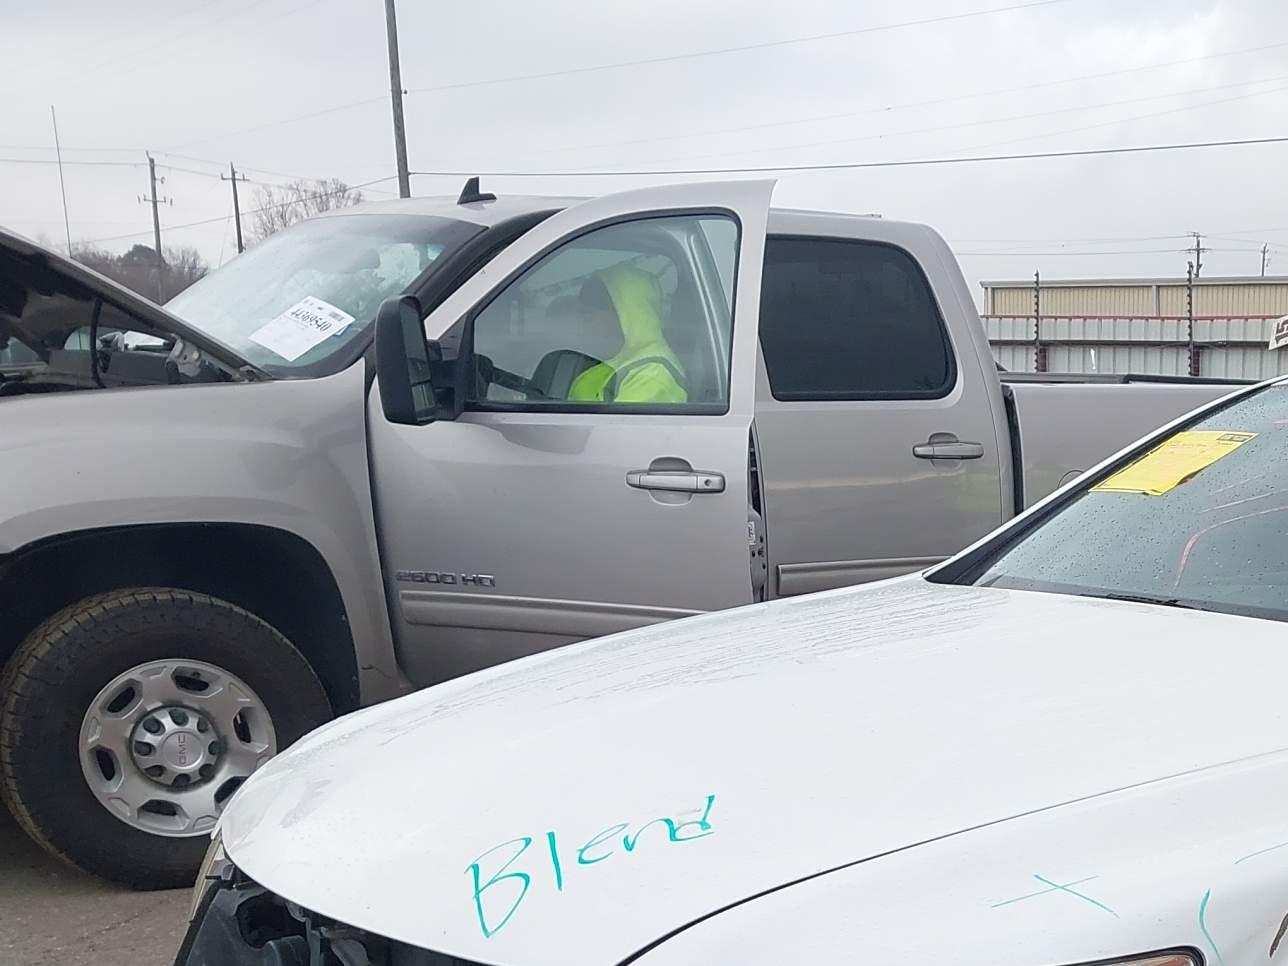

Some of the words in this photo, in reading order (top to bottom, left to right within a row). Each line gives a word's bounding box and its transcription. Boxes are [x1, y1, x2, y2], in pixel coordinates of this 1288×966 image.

[460, 573, 496, 587] HD
[177, 735, 186, 765] GMC
[463, 794, 716, 939] Blend
